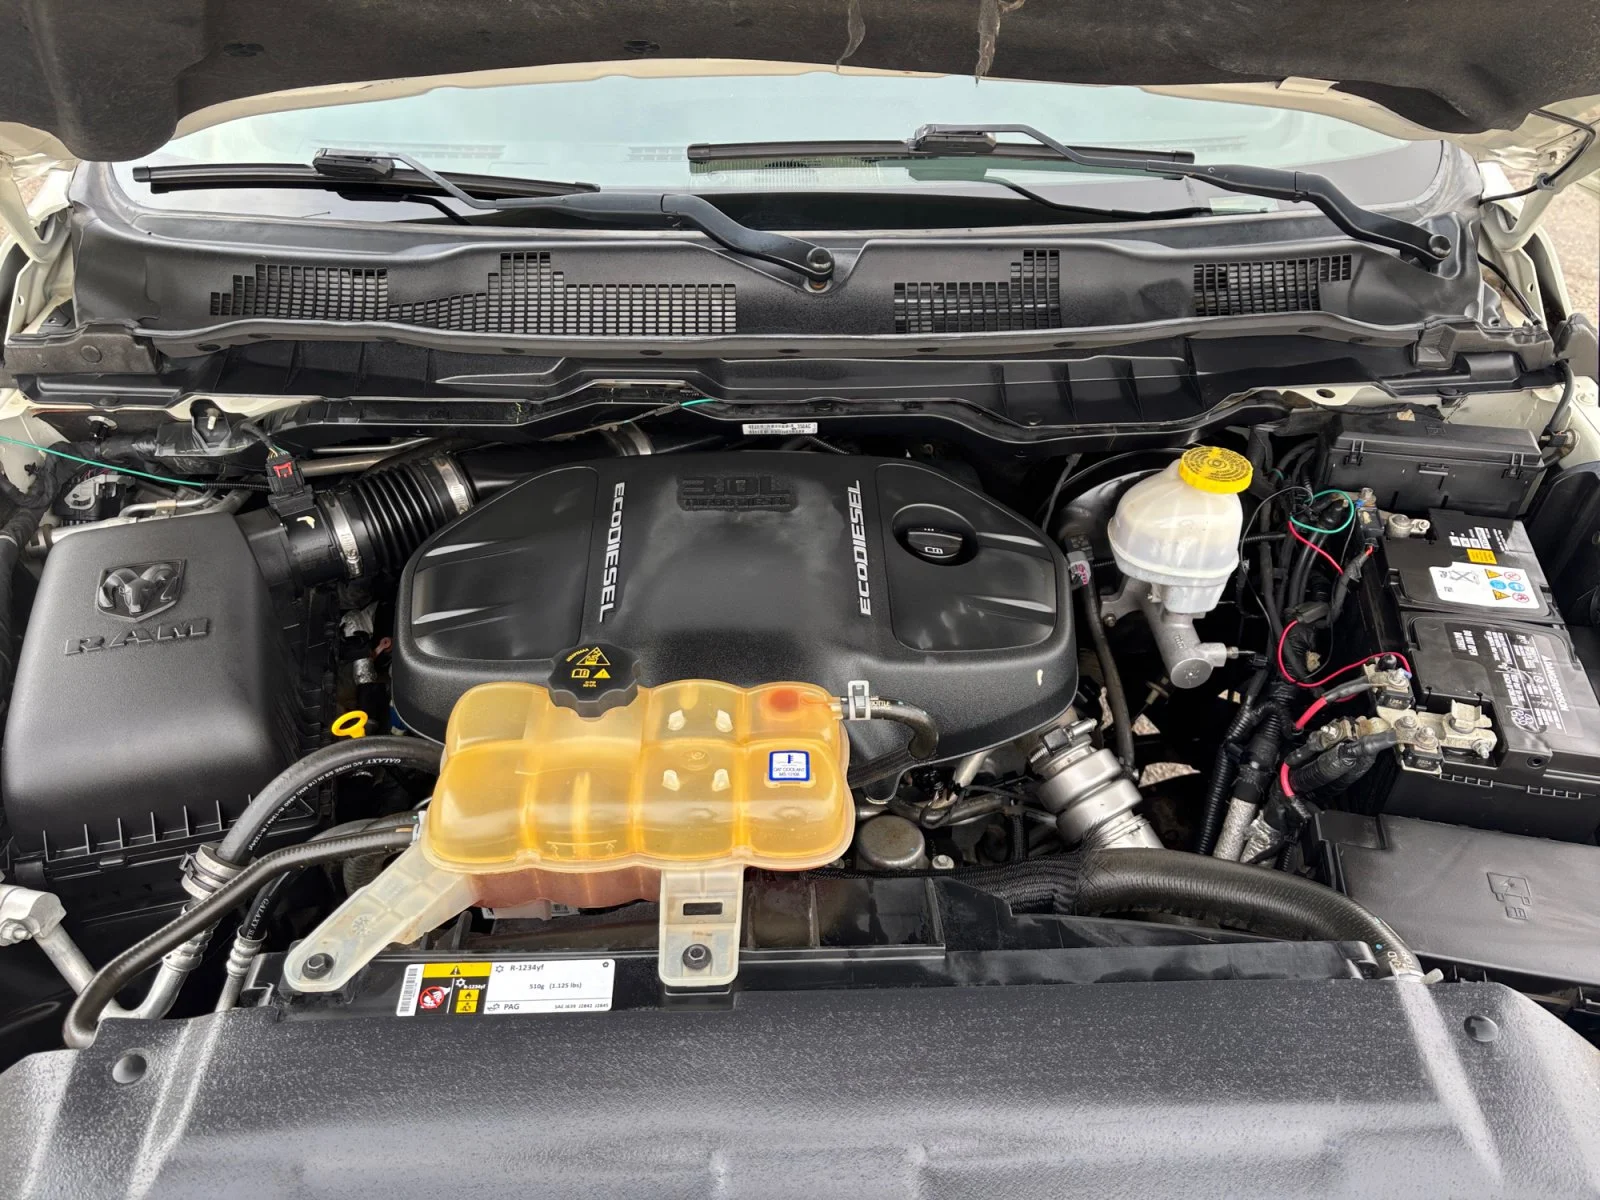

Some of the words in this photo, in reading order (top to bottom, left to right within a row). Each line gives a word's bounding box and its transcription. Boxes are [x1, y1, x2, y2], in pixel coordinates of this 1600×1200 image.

[599, 481, 626, 623] ECODIESEL
[847, 479, 871, 616] ECODIESEL
[65, 617, 211, 656] RAM
[334, 764, 352, 773] HOSE
[251, 898, 270, 929] GALAXY
[510, 963, 544, 972] R-1234yf
